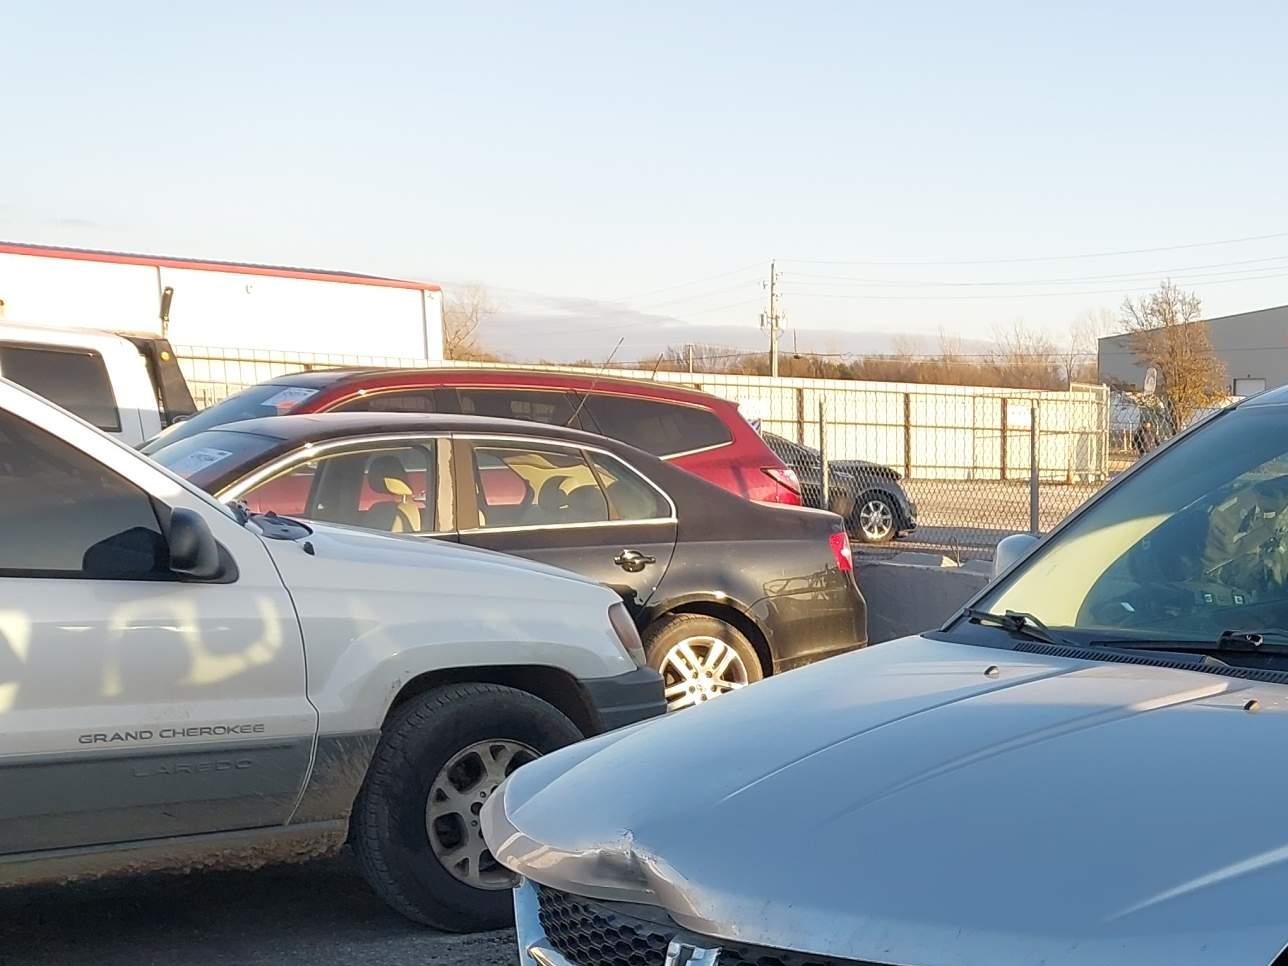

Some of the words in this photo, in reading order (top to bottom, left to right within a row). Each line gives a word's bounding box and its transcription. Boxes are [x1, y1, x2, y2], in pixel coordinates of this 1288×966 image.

[78, 730, 153, 744] GRAND
[159, 723, 265, 739] CHEROKEE
[131, 759, 252, 778] LAREDO
